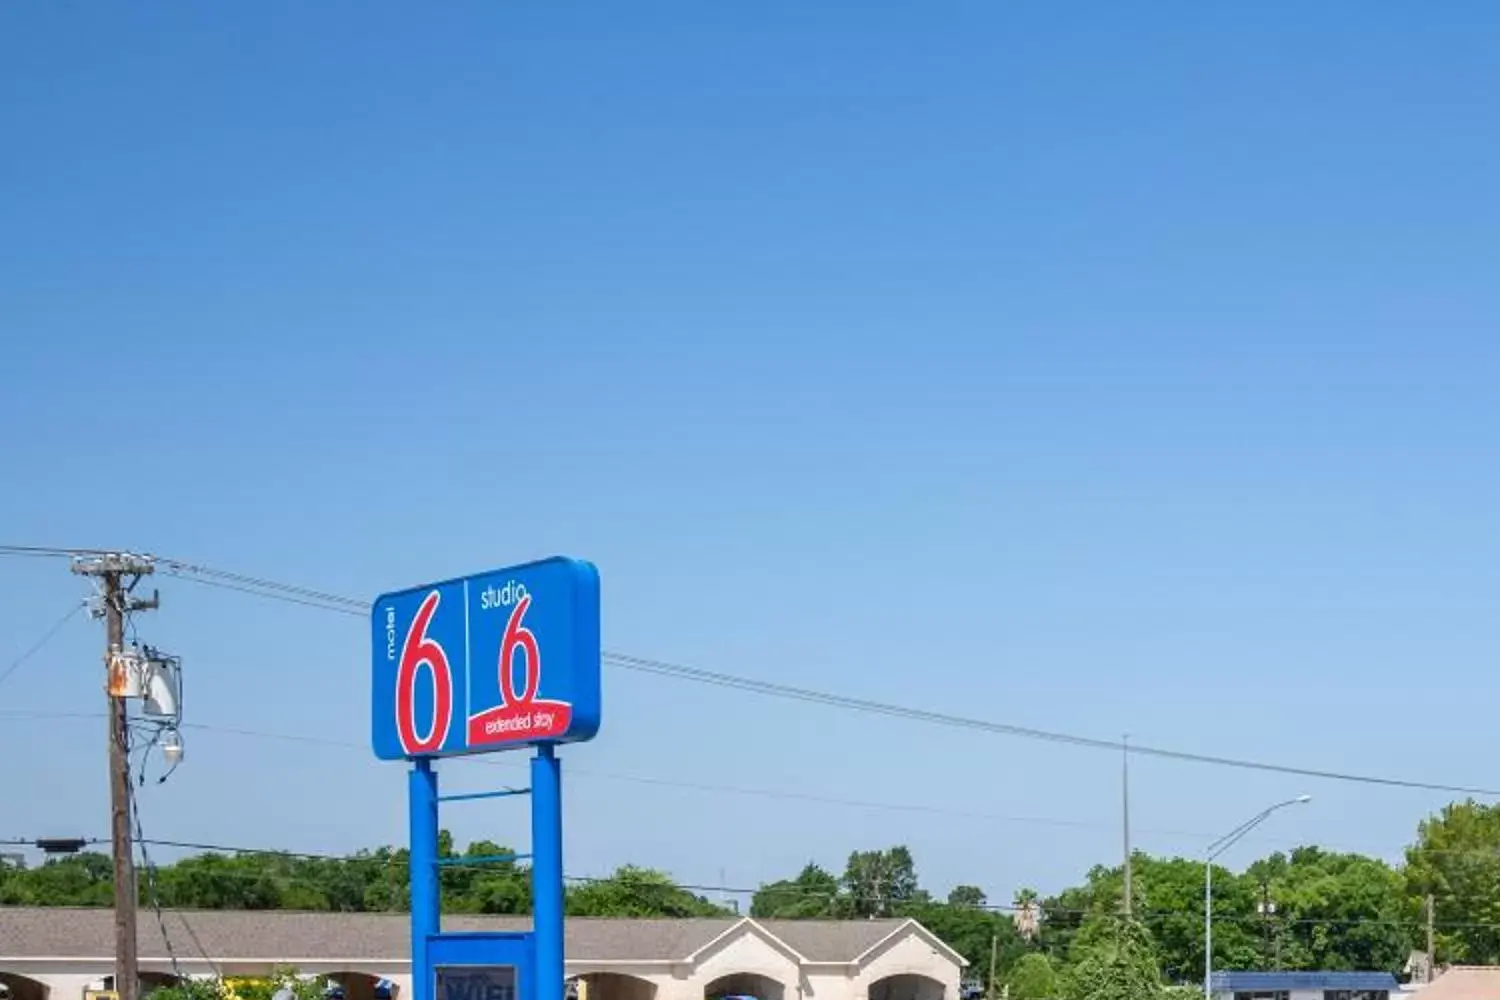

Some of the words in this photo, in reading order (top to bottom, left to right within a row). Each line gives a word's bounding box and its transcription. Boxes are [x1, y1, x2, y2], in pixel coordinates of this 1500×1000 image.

[481, 580, 527, 610] studio
[384, 606, 396, 660] motel
[498, 593, 541, 704] 6
[395, 589, 453, 754] 6
[485, 712, 531, 735] extended
[533, 712, 555, 731] stay
